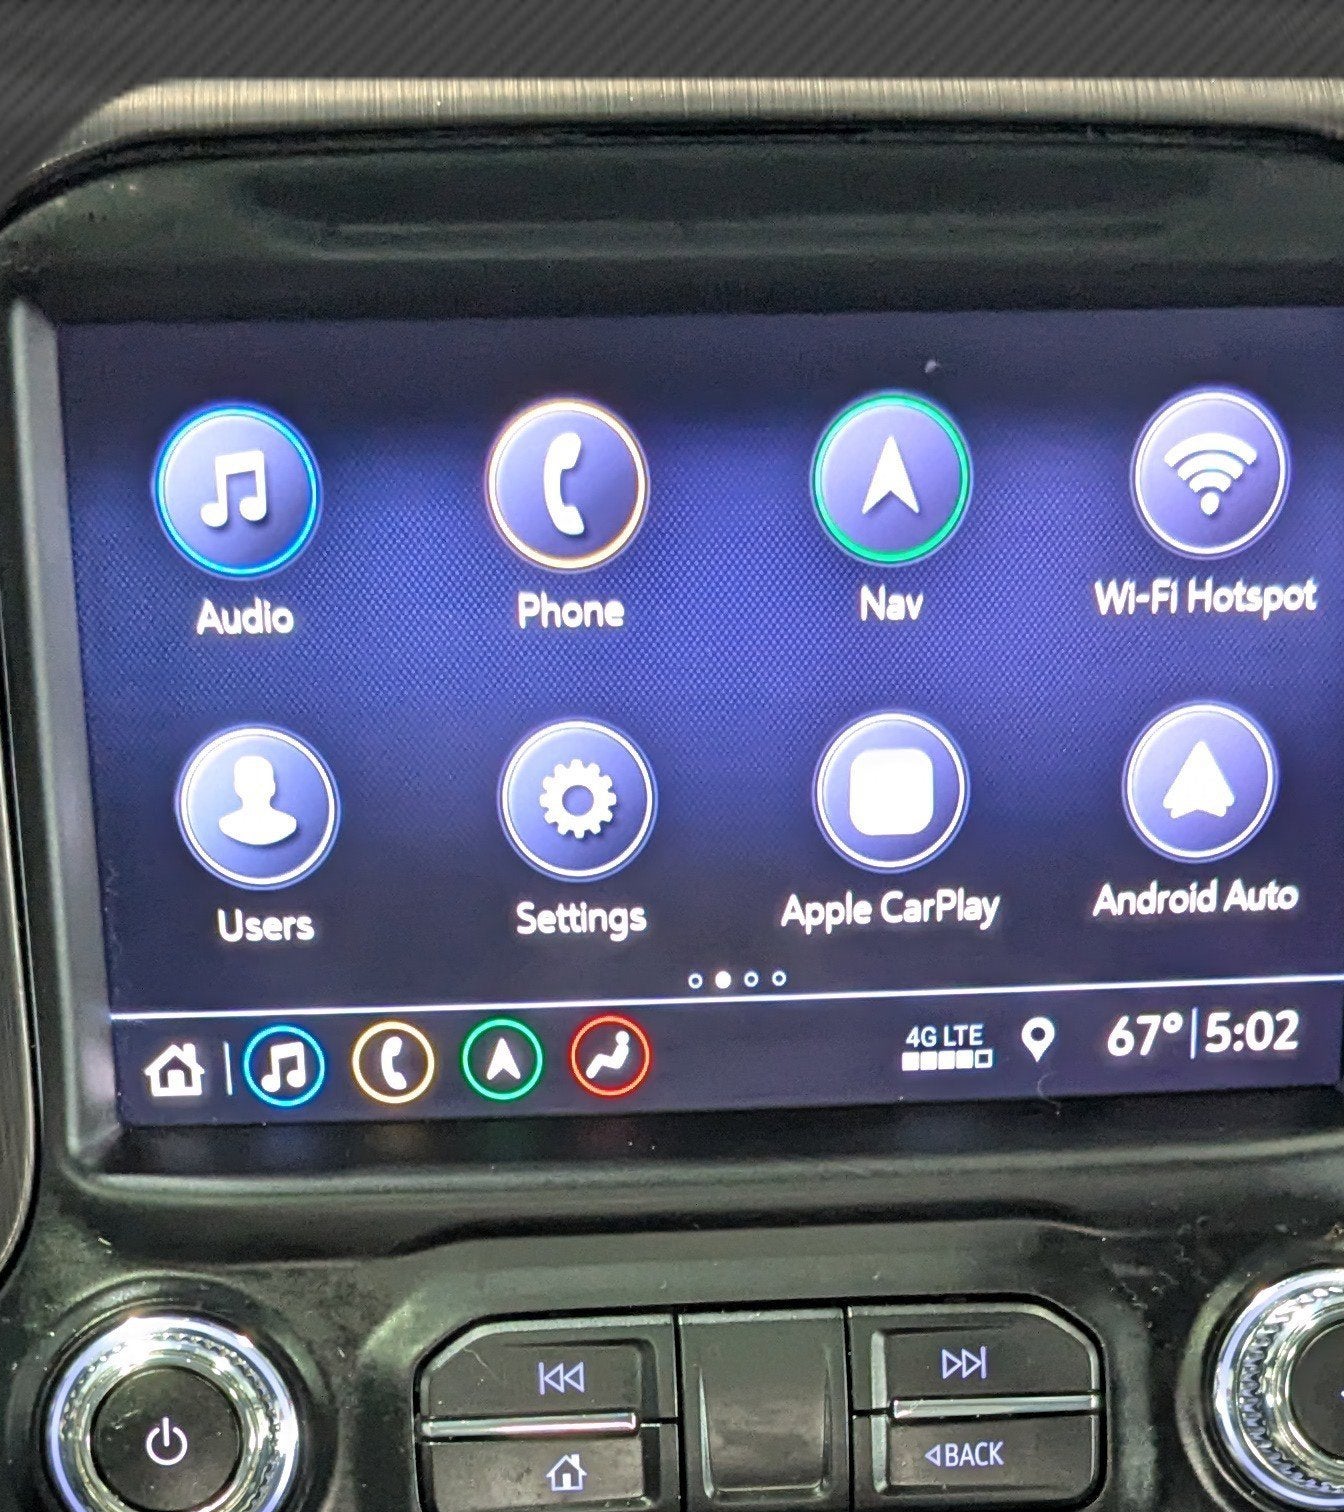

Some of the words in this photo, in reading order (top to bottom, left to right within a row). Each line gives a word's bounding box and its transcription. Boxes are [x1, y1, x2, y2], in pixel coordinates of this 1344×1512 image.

[196, 596, 295, 636] Audio
[517, 590, 626, 629] Phone
[860, 584, 924, 622] Nav
[1094, 577, 1178, 616] Wi-Fi
[1187, 578, 1318, 620] Hotspot
[780, 890, 873, 934] Apple
[880, 887, 1001, 931] CarPlay
[1092, 878, 1218, 917] Android
[1222, 878, 1299, 913] Auto
[217, 908, 315, 943] Users
[516, 901, 648, 942] Settings
[905, 1024, 938, 1048] 4G
[943, 1023, 984, 1047] LTE
[1107, 1011, 1184, 1057] 67°
[1204, 1009, 1299, 1053] 5:02
[944, 1441, 1004, 1467] BACK
